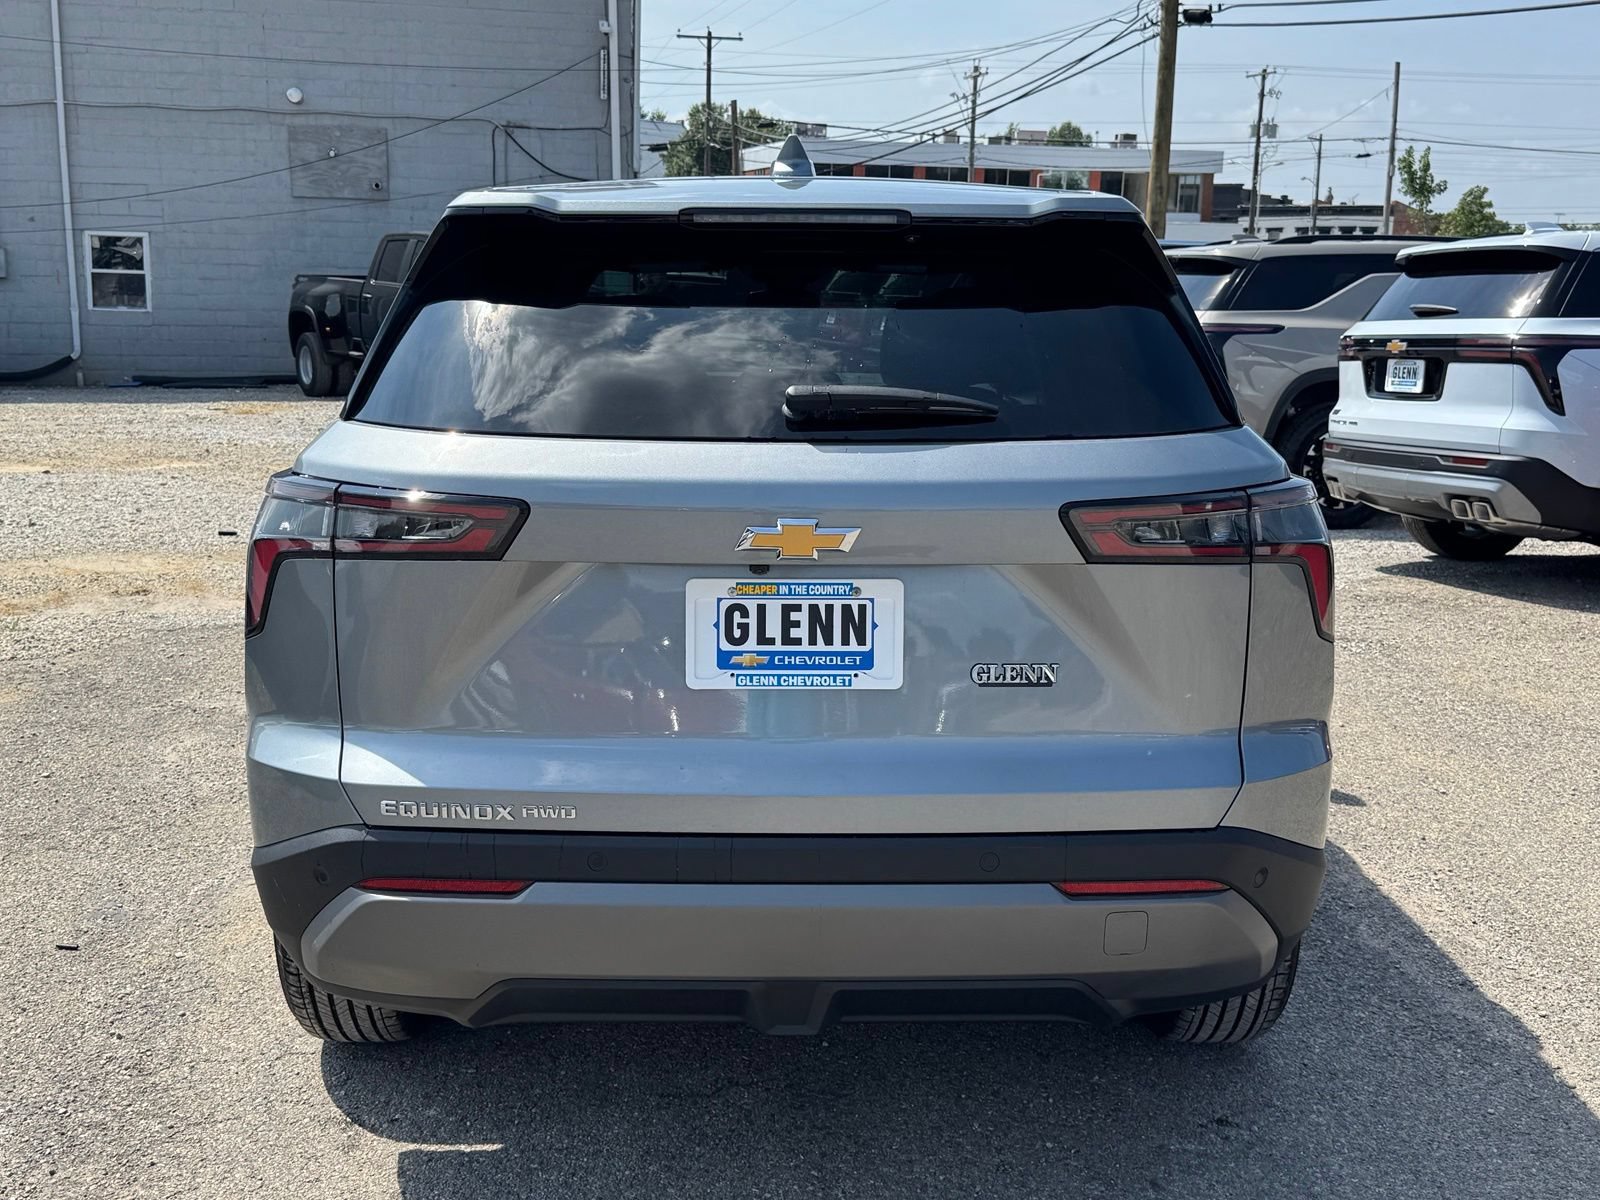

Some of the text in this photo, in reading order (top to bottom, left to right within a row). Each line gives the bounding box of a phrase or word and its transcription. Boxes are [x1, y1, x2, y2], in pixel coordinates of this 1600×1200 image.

[1392, 366, 1417, 380] GLENN
[736, 584, 853, 595] CHEAPER IN THE COUNTRY.
[724, 602, 867, 647] GLENN
[774, 655, 863, 665] CHEVROLET
[737, 676, 851, 686] GLENN CHEVROLET
[970, 662, 1060, 686] GLENN
[380, 800, 576, 821] EQUINOX AWD
